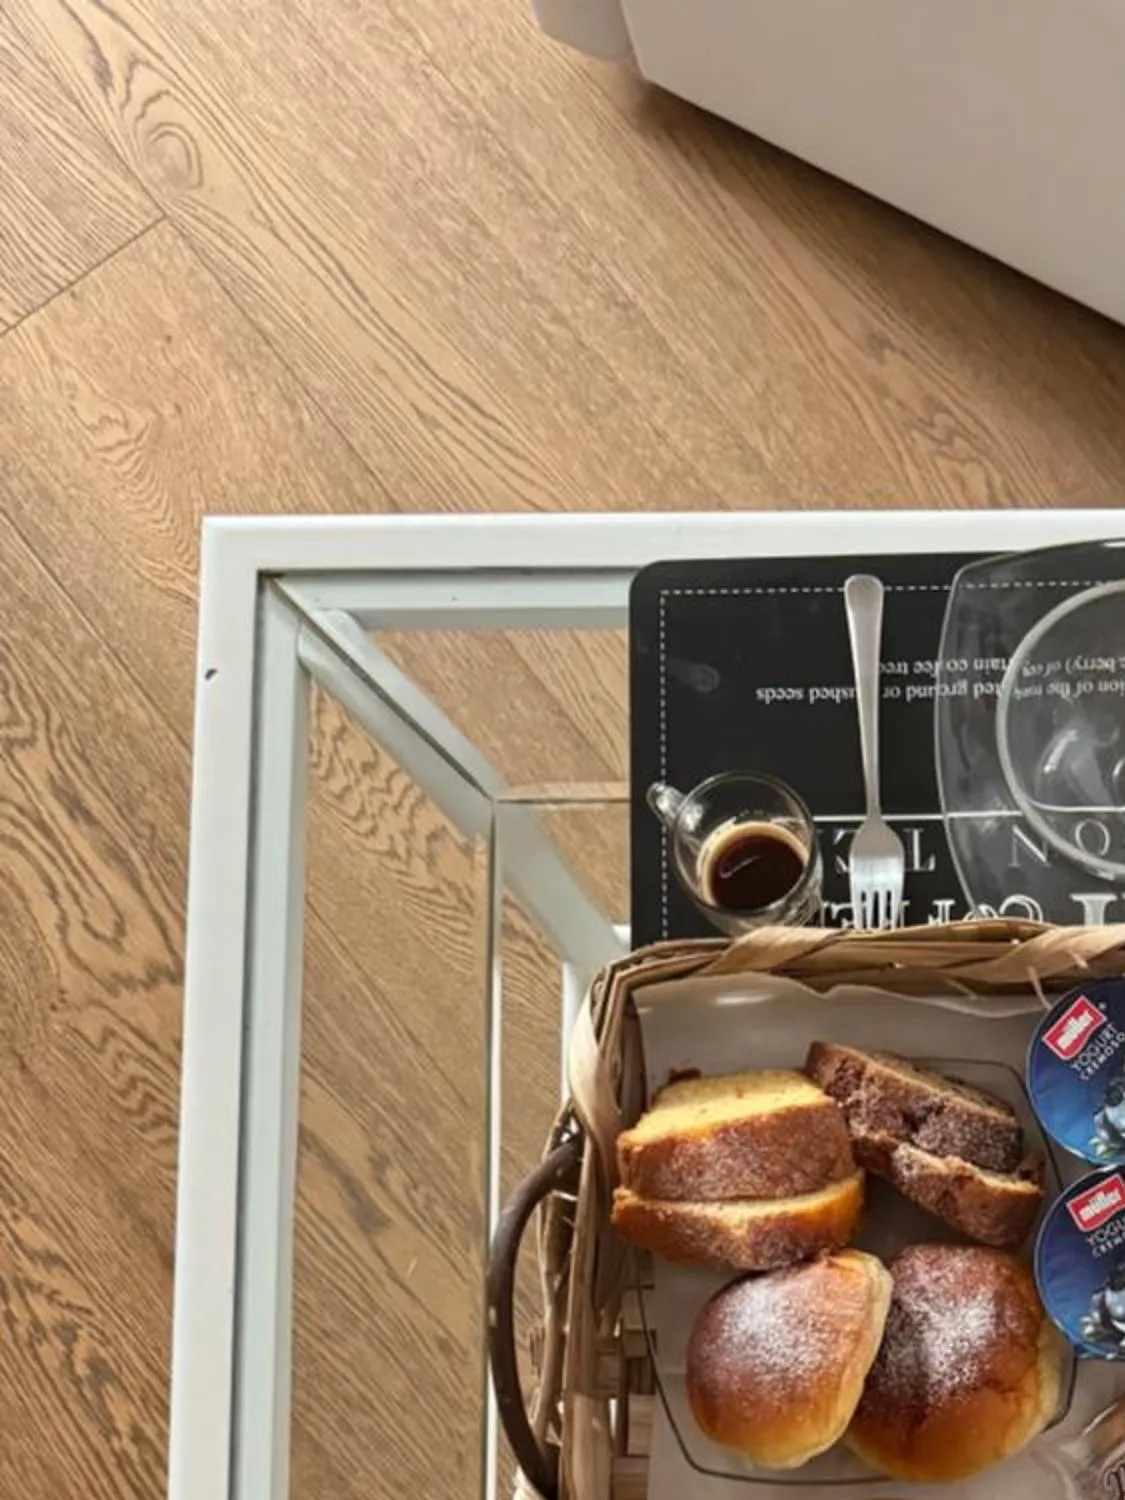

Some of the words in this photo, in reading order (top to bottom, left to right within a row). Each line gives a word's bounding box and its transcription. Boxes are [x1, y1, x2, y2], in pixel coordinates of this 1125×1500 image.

[913, 659, 968, 677] cofee
[756, 686, 804, 704] seeds
[883, 685, 901, 699] or
[1074, 680, 1094, 698] of
